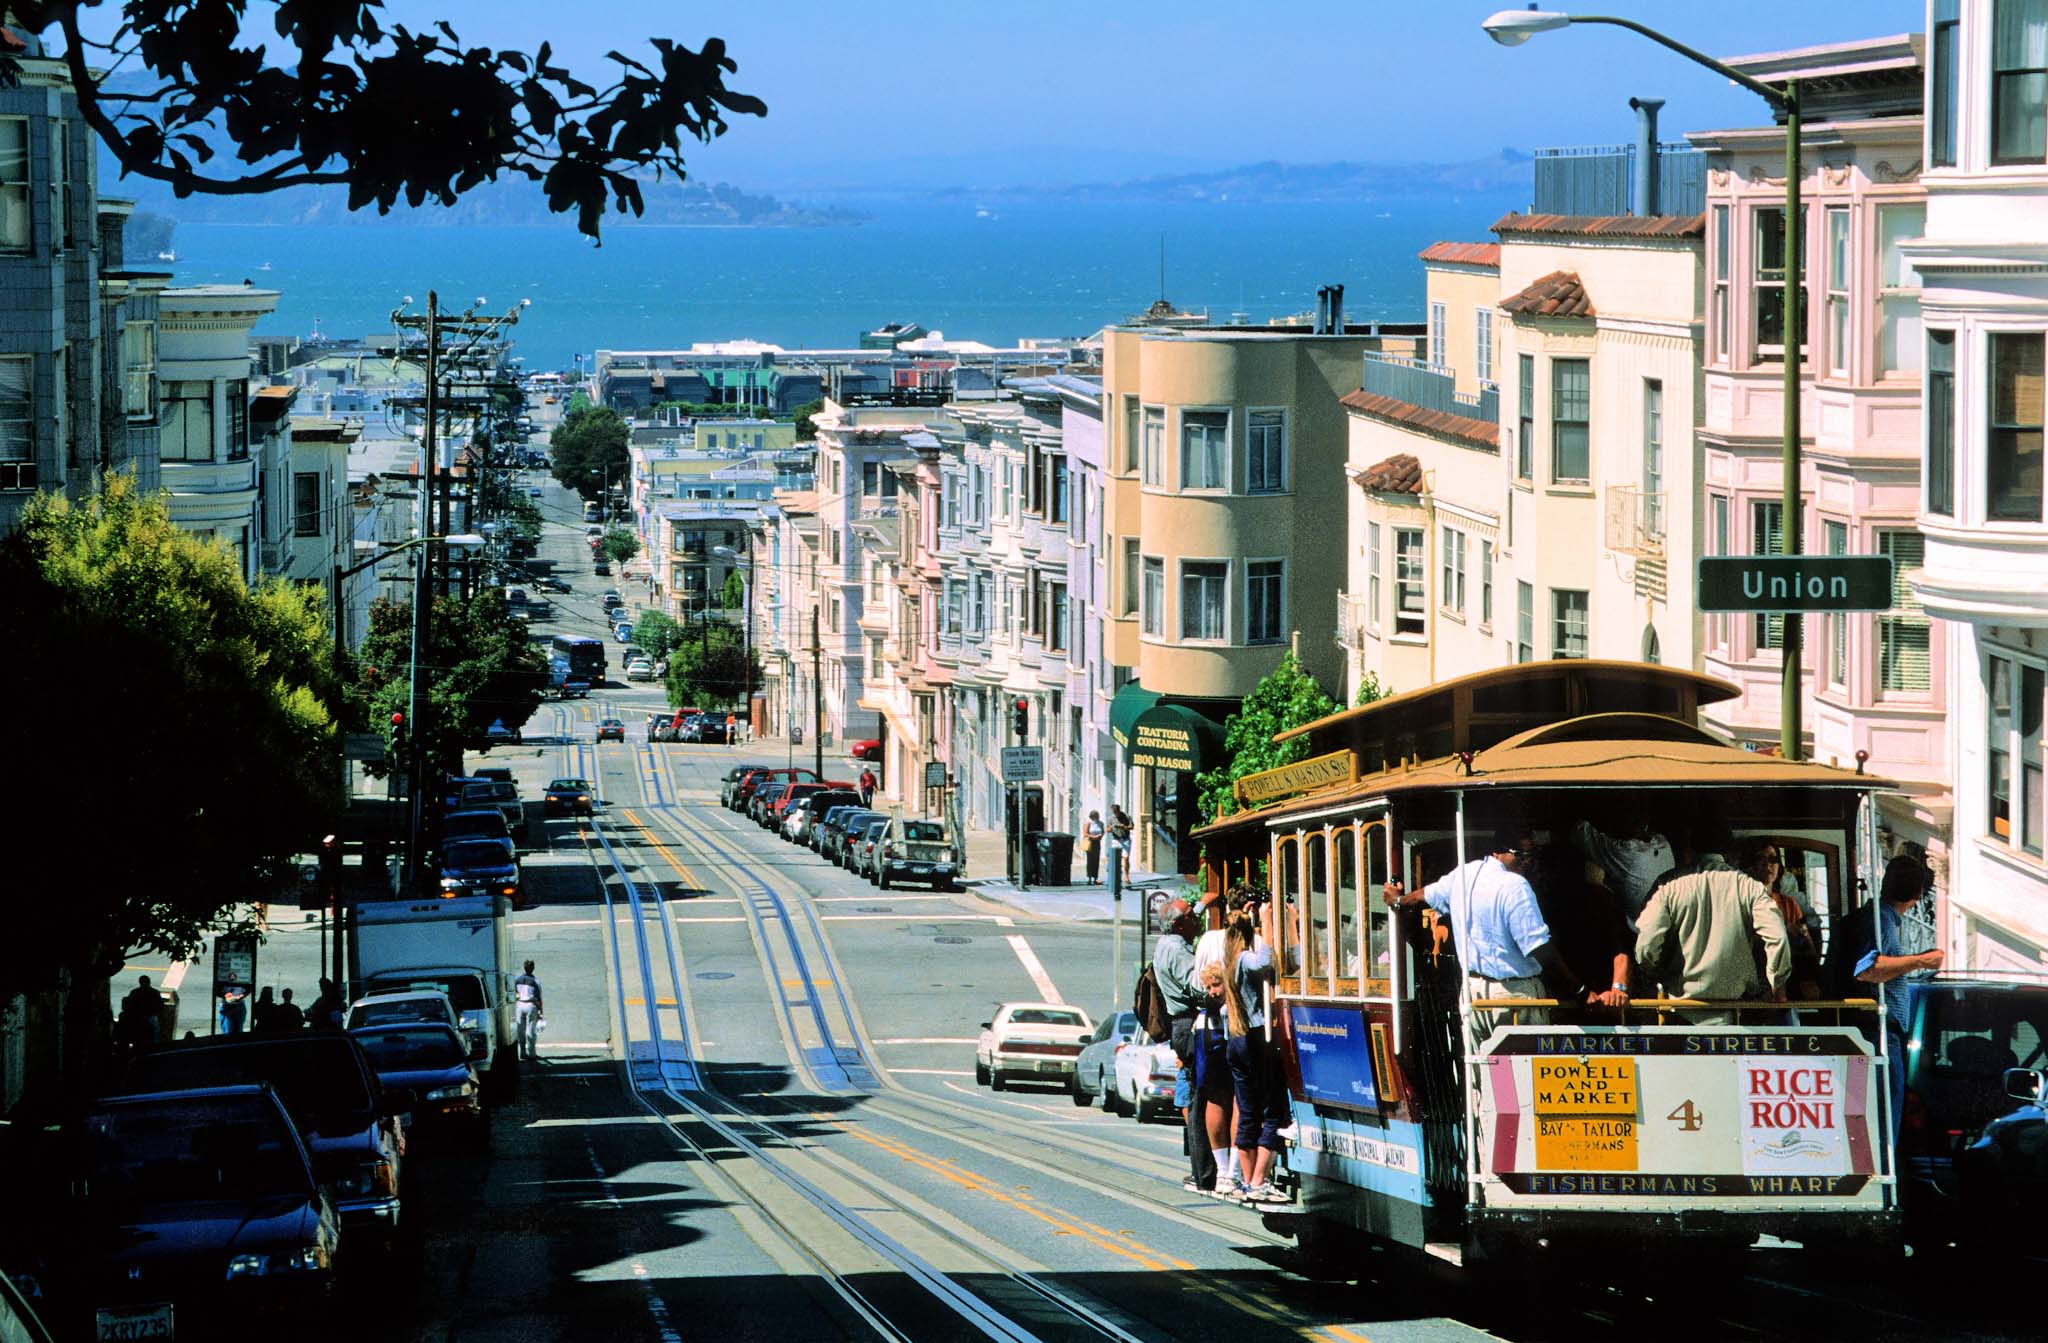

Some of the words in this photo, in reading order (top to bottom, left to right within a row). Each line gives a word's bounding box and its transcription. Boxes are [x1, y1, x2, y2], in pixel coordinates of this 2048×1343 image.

[1743, 571, 1848, 599] Union
[1137, 726, 1190, 741] TRATTORIA
[1137, 736, 1190, 752] CONTADINA
[1133, 753, 1154, 767] 1800
[1156, 756, 1192, 770] MASON
[1246, 774, 1284, 797] POWELL
[1291, 760, 1331, 787] MASON
[1538, 1036, 1655, 1052] MARKET
[1685, 1036, 1795, 1052] STREET
[1540, 1066, 1630, 1079] POWELL
[1564, 1080, 1608, 1090] AND
[1747, 1068, 1834, 1096] RICE
[1540, 1092, 1632, 1104] MARKET
[1667, 1099, 1703, 1131] 4
[1749, 1101, 1835, 1129] RONI
[1540, 1122, 1563, 1137] BAY
[1583, 1122, 1632, 1137] TAYLOR
[1530, 1176, 1717, 1193] FISHERMANS
[1748, 1177, 1841, 1193] WHARF
